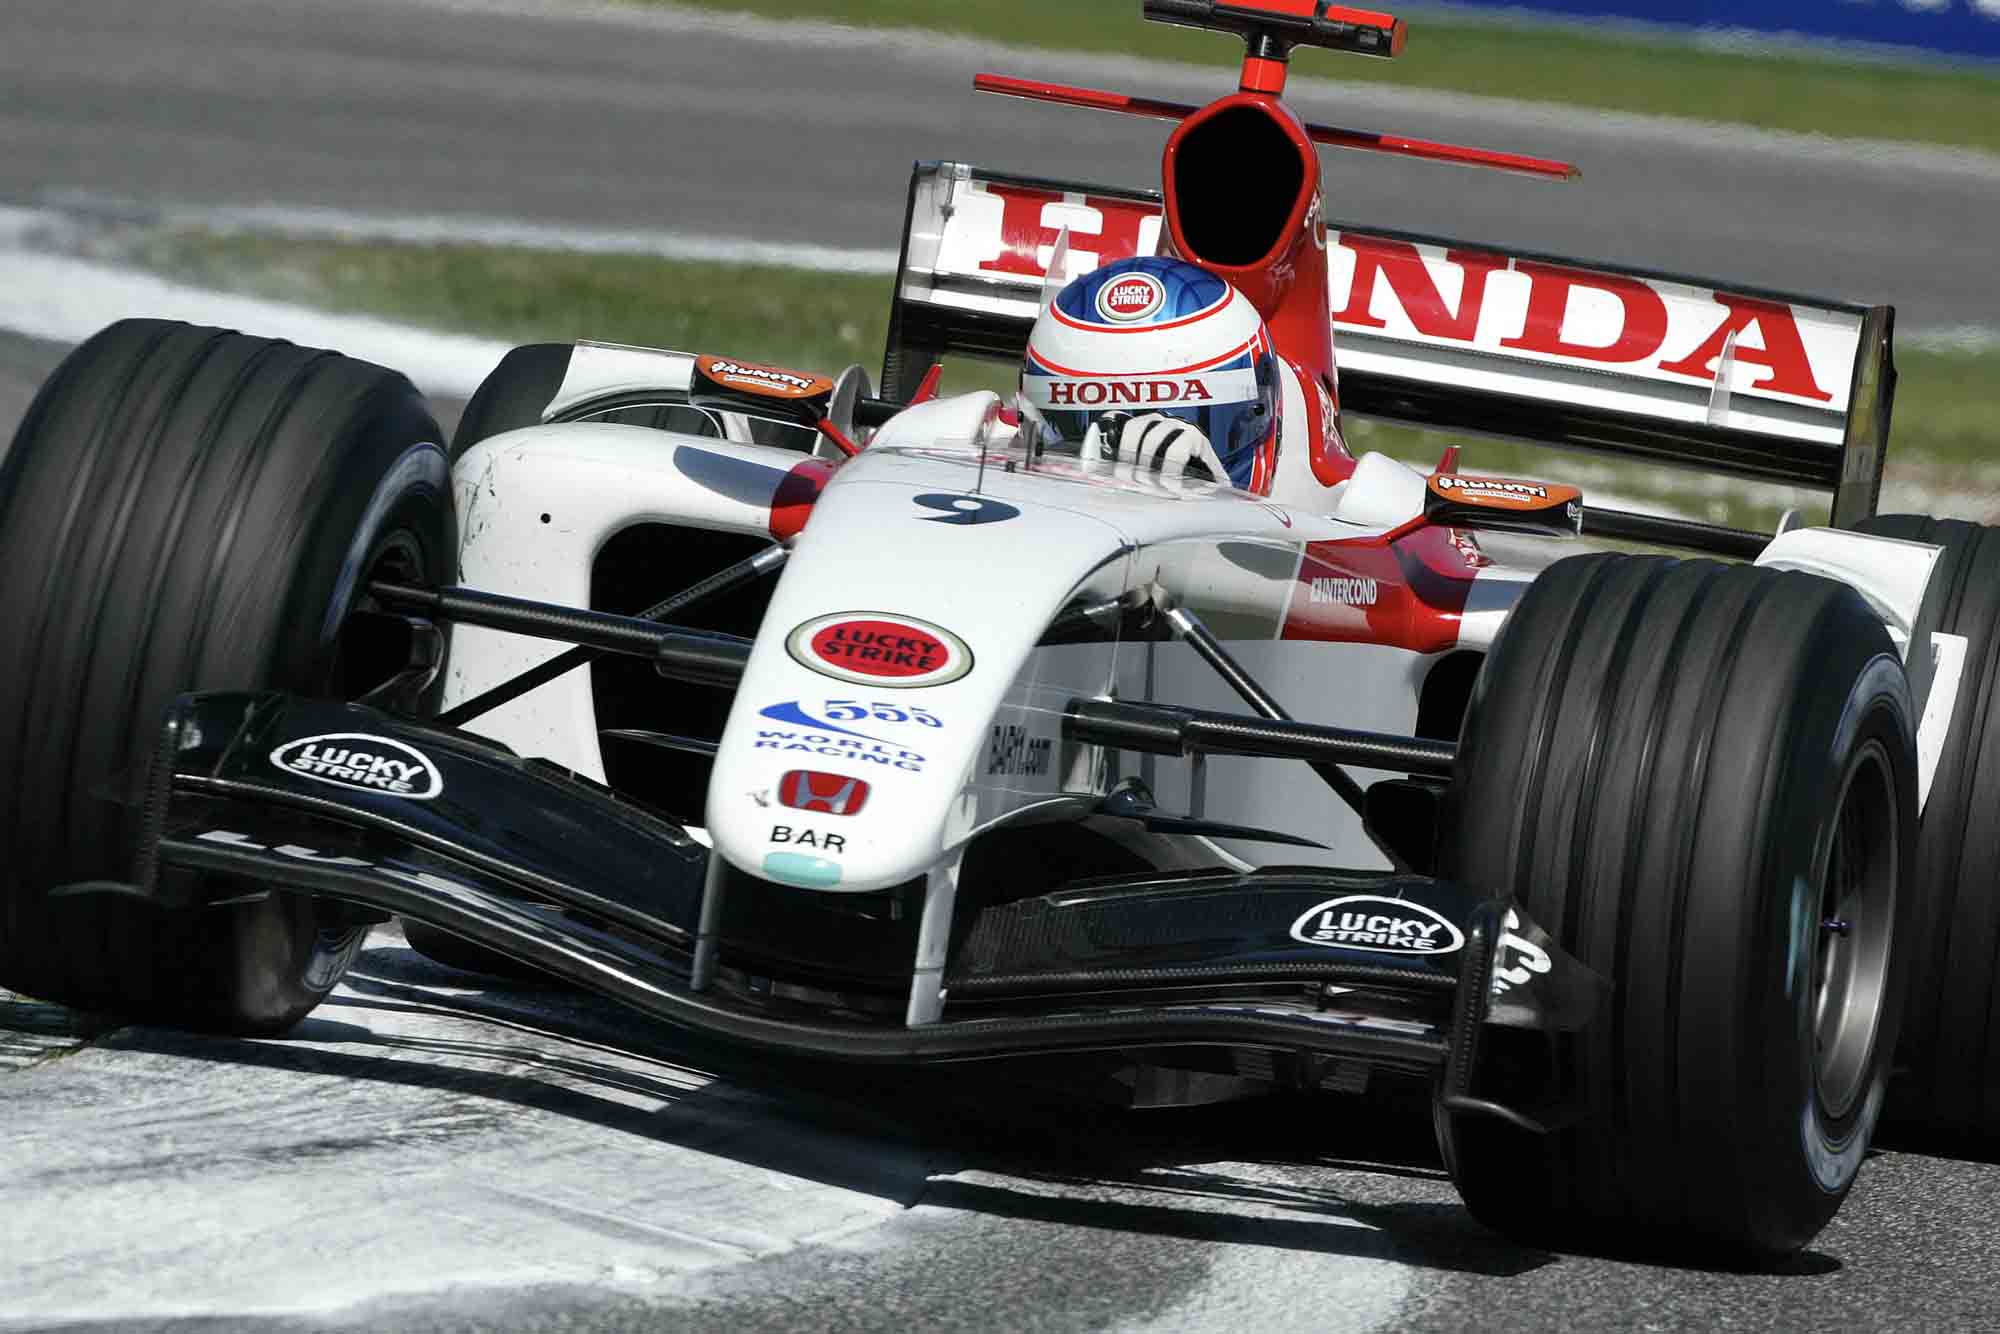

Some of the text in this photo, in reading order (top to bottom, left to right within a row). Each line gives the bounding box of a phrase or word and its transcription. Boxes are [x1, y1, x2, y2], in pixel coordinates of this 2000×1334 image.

[978, 183, 1833, 402] HNDA
[1110, 294, 1150, 306] STRIKE
[1113, 285, 1150, 296] LUCKY
[1048, 379, 1213, 405] HONDA
[821, 641, 937, 670] STRIKE
[833, 628, 942, 655] LUCKY
[824, 699, 944, 729] 555
[753, 740, 922, 772] RACING
[757, 731, 927, 762] WORLD
[288, 758, 414, 794] STRIKE
[301, 744, 424, 782] LUCKY
[769, 825, 847, 854] BAR
[1318, 911, 1443, 939] LUCKY
[1311, 930, 1438, 950] STRIKE
